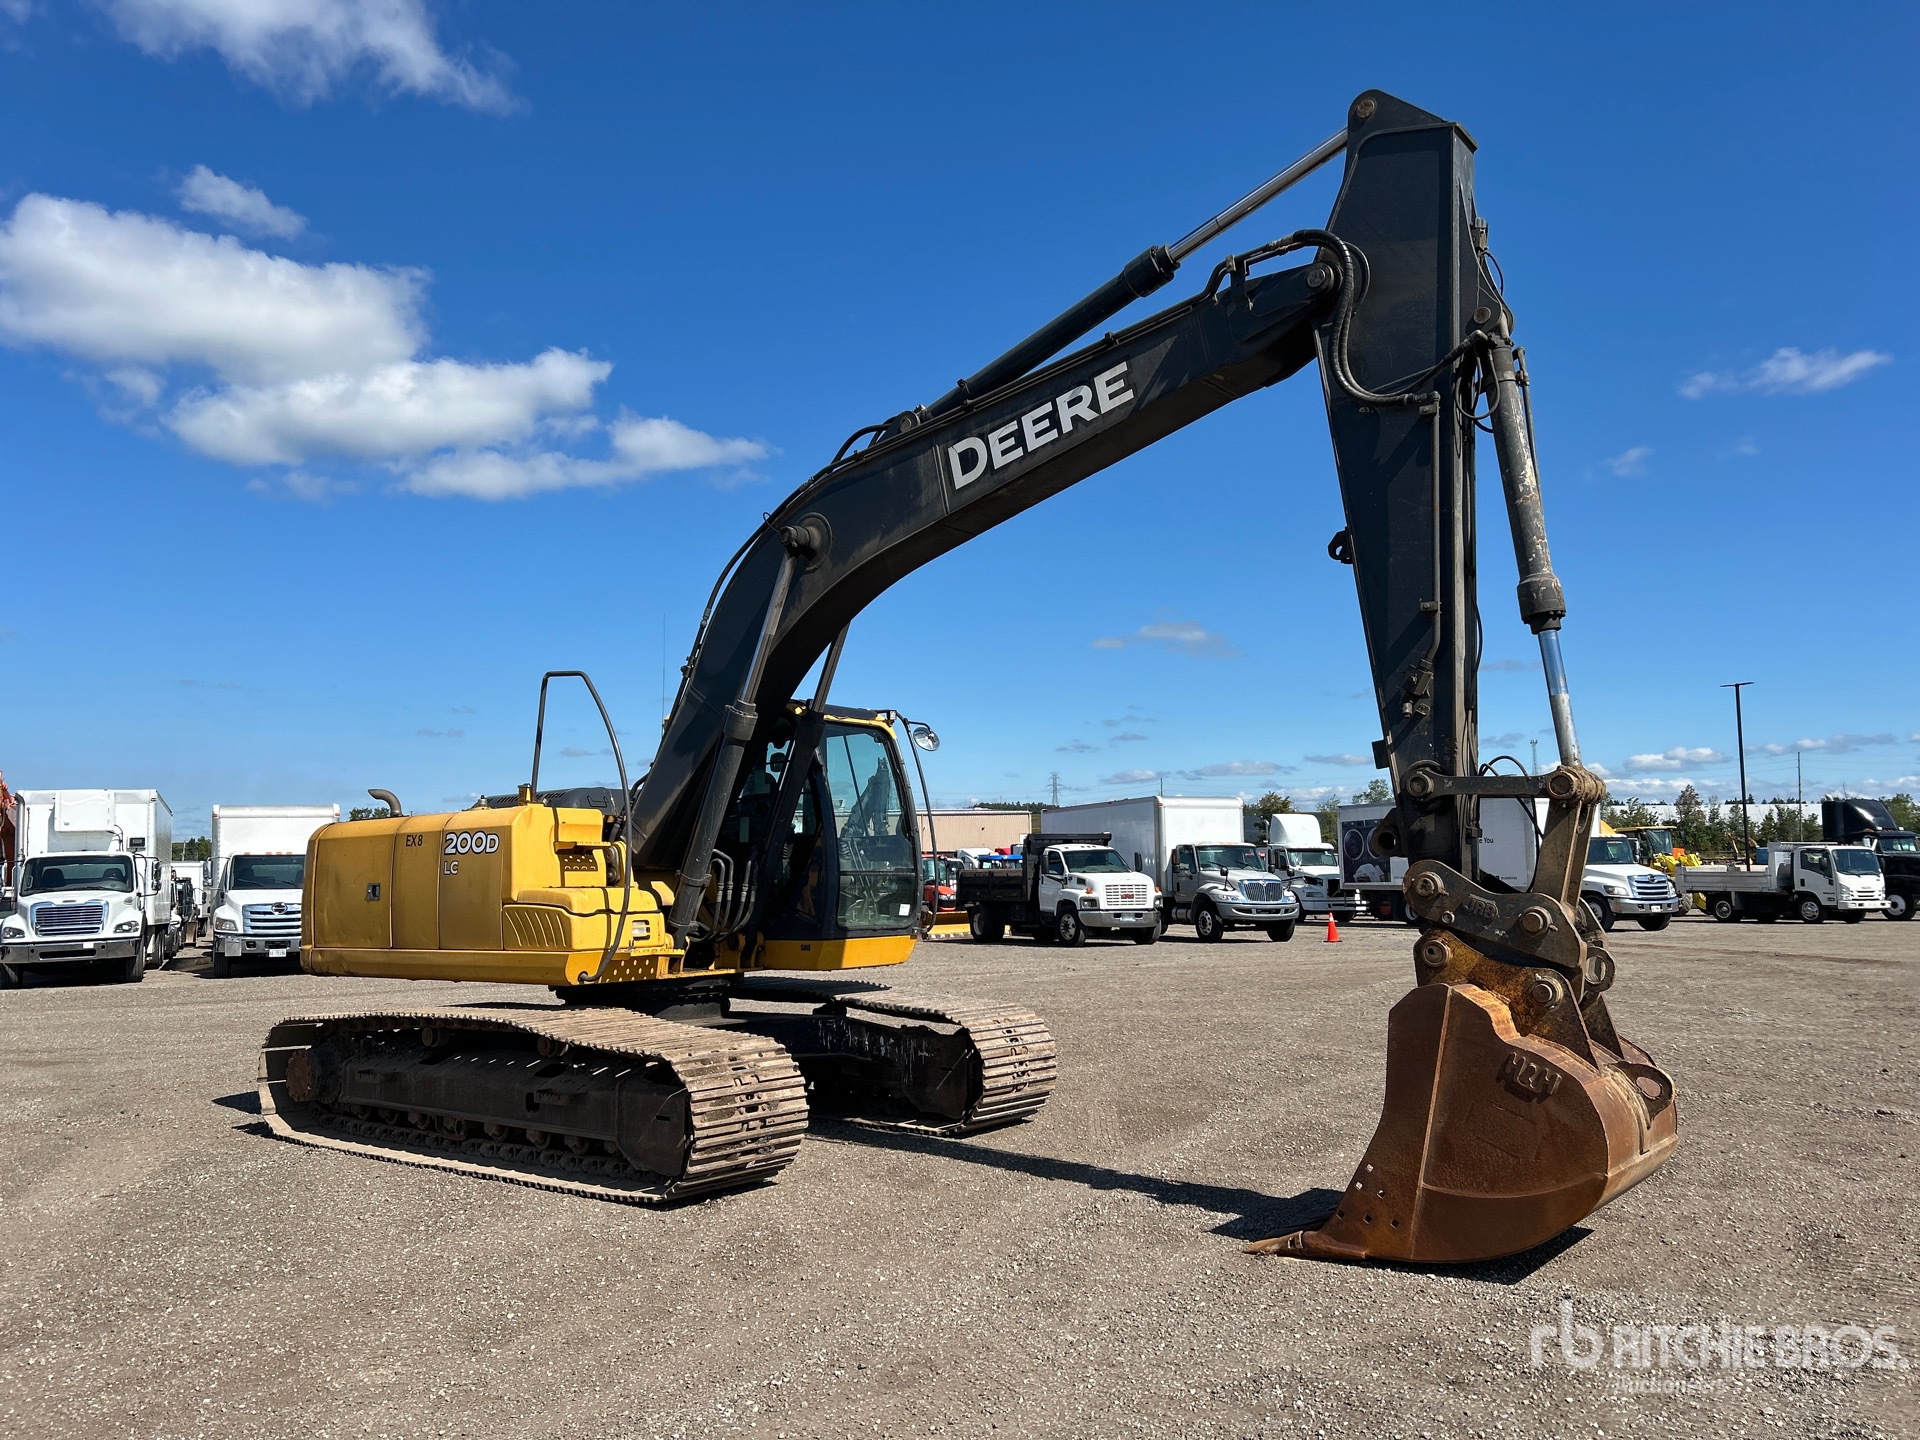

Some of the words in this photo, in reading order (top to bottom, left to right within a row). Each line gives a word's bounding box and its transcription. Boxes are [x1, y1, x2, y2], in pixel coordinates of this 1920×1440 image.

[948, 361, 1135, 490] DEERE
[443, 830, 500, 855] 200D
[443, 860, 460, 875] LC
